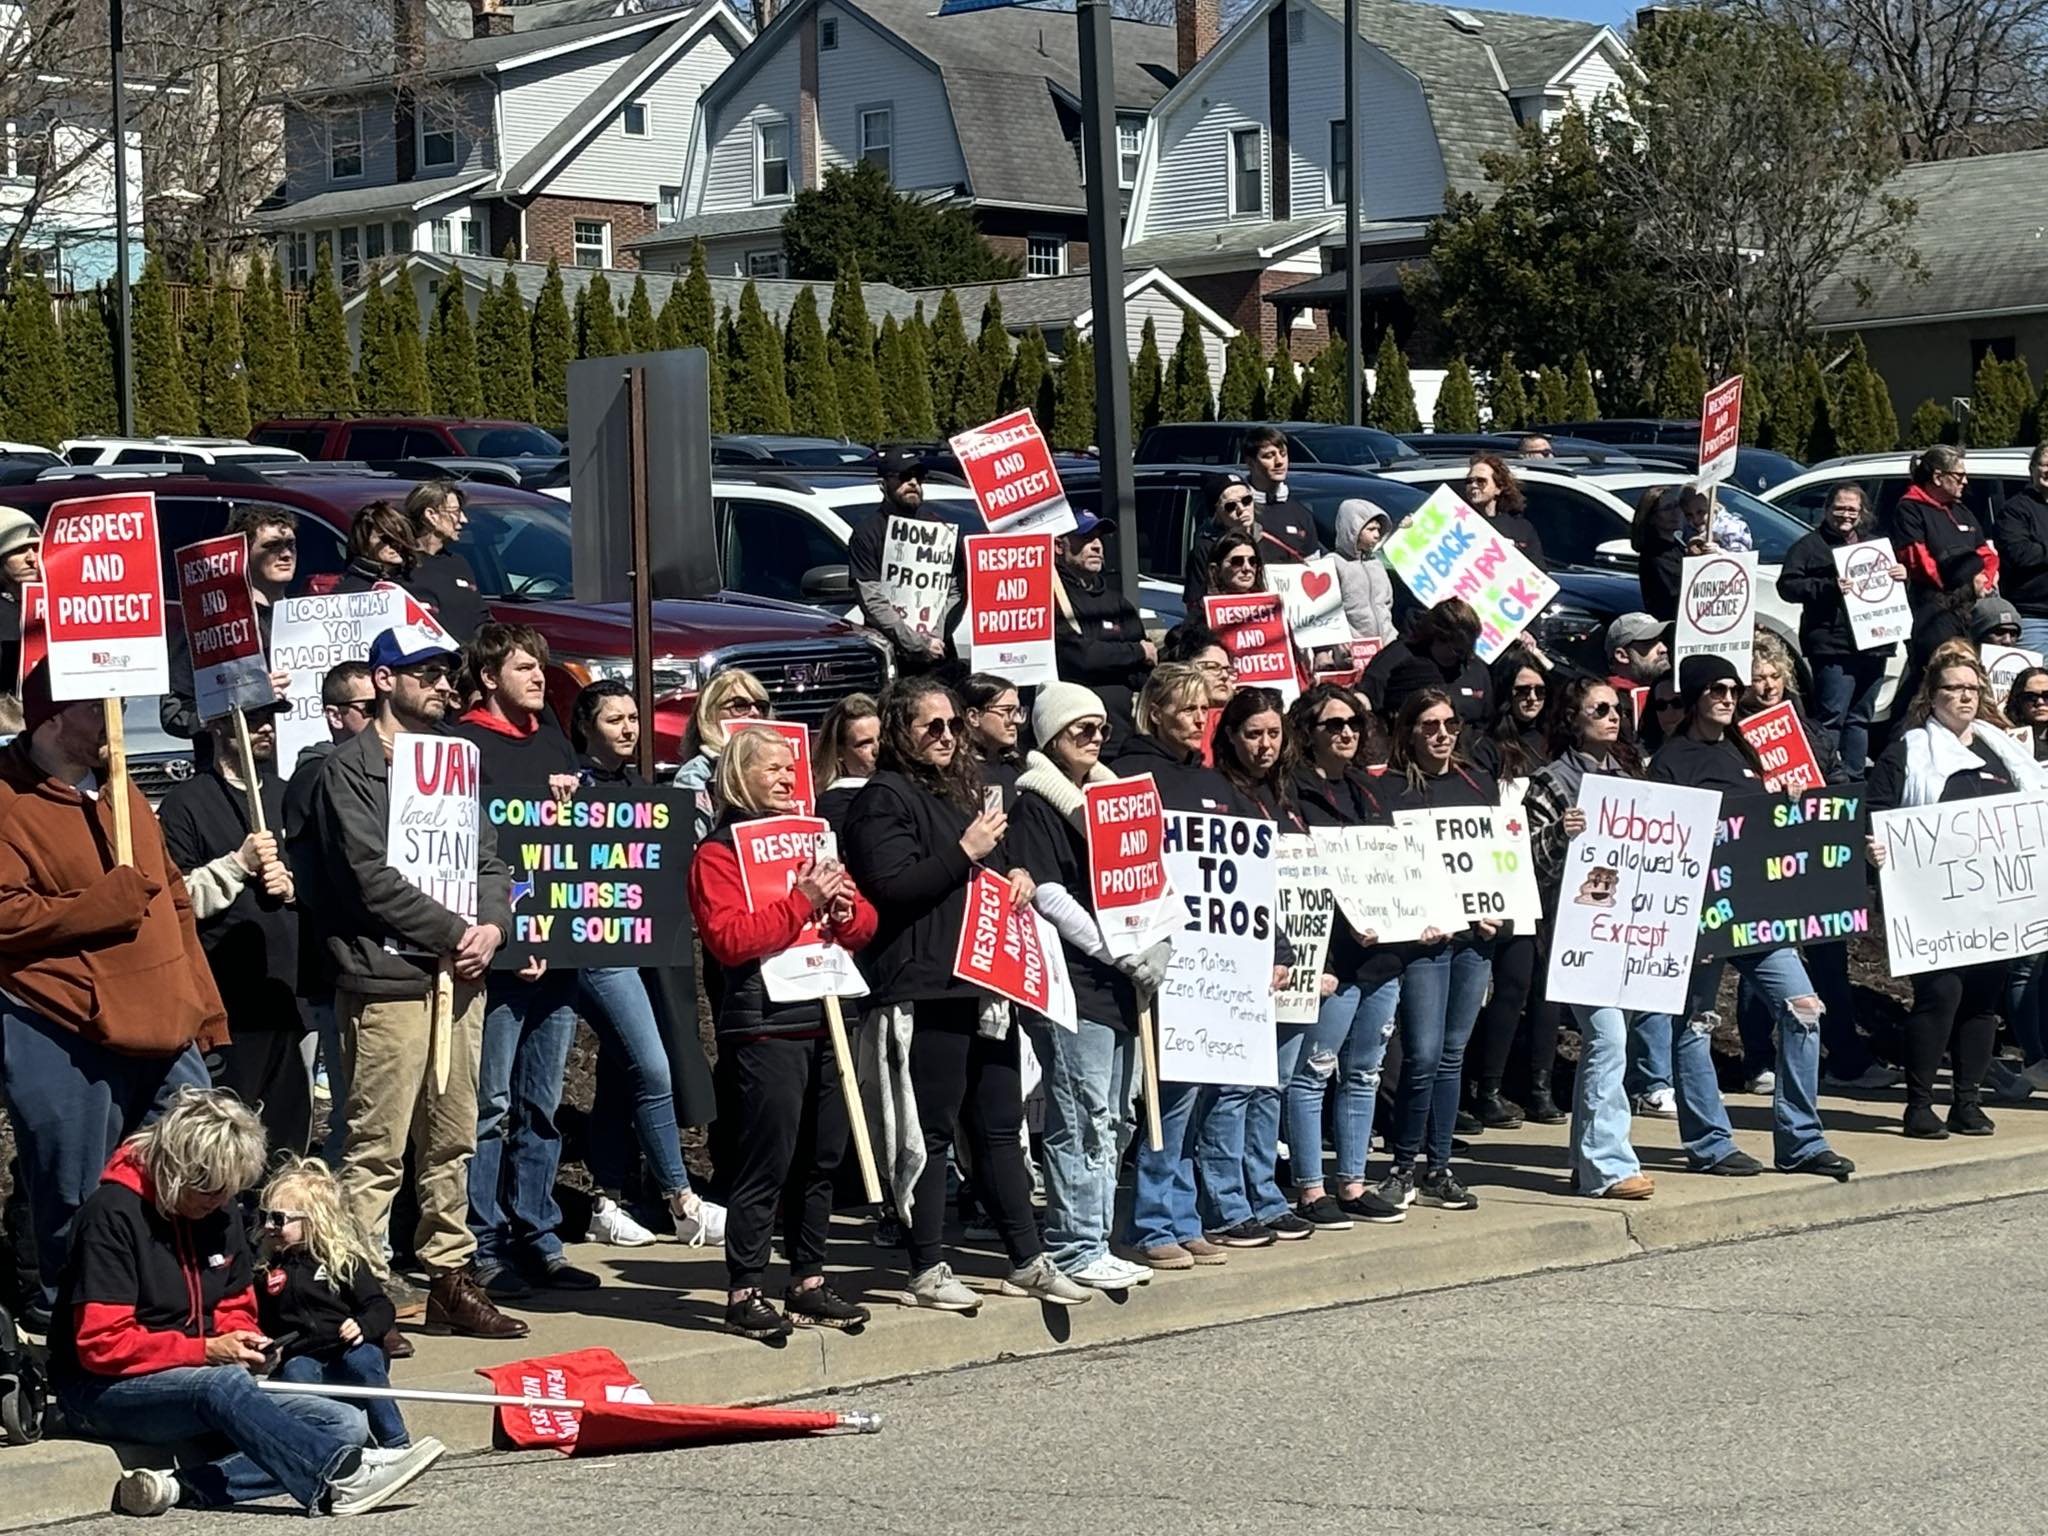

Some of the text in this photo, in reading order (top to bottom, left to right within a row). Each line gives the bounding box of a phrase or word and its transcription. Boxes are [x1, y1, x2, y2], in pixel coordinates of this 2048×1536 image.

[993, 452, 1025, 480] AND
[984, 469, 1051, 512] PROTECT
[53, 512, 145, 544] RESPECT
[890, 520, 938, 545] HOW
[977, 545, 1045, 571] RESPECT
[1425, 522, 1477, 579] BACK
[81, 554, 124, 583] AND
[184, 550, 239, 586] RESPECT
[886, 563, 953, 591] PROFIT
[1453, 567, 1482, 601] MY
[1474, 537, 1507, 580] PAY
[202, 589, 228, 617] AND
[996, 578, 1028, 601] AND
[1692, 579, 1745, 599] WORKPLACE
[59, 593, 152, 625] PROTECT
[286, 592, 390, 623] LOOK WHAT
[978, 607, 1046, 633] PROTECT
[1215, 604, 1276, 626] RESPECT
[194, 618, 250, 653] PROTECT
[323, 621, 362, 643] YOU
[1236, 630, 1265, 650] AND
[275, 644, 342, 670] MADE
[1234, 653, 1286, 673] ROTECT
[784, 662, 846, 684] GMC
[284, 697, 324, 721] PIC
[1760, 746, 1789, 772] AND
[399, 795, 448, 827] local
[489, 798, 670, 829] CONCESSIONS
[1097, 792, 1156, 825] RESPECT
[1774, 797, 1859, 827] SAFETY
[1163, 816, 1272, 858] HEROS
[1436, 817, 1494, 841] FROM
[1599, 796, 1692, 858] Nobody
[1886, 800, 2048, 871] MY SAFET
[521, 842, 662, 871] WILL MAKE
[1120, 829, 1147, 858] AND
[1404, 835, 1425, 861] My
[1199, 856, 1238, 894] TO
[1491, 851, 1518, 874] TO
[1580, 843, 1700, 879] is allowed to
[1712, 845, 1851, 891] IS NOT UP
[1101, 861, 1159, 895] PROTECT
[1938, 854, 2037, 900] IS NOT
[550, 881, 643, 910] NURSES
[1279, 888, 1291, 912] IF
[1297, 886, 1334, 911] YOUR
[1462, 891, 1505, 915] ERO
[516, 915, 652, 944] FLY SOUTH
[970, 877, 1000, 972] RESPECT
[1184, 895, 1270, 940] EROS
[1285, 914, 1328, 938] NURSE
[1733, 908, 1868, 947] NEGOTIATION
[1004, 912, 1022, 962] AND
[1591, 913, 1670, 957] Except
[1019, 912, 1041, 998] PROTEC
[1198, 947, 1237, 974] Raises
[1561, 949, 1689, 986] our patients!
[1164, 978, 1194, 998] Zero
[1288, 968, 1316, 993] AFE
[1164, 1027, 1247, 1061] Zero Respect
